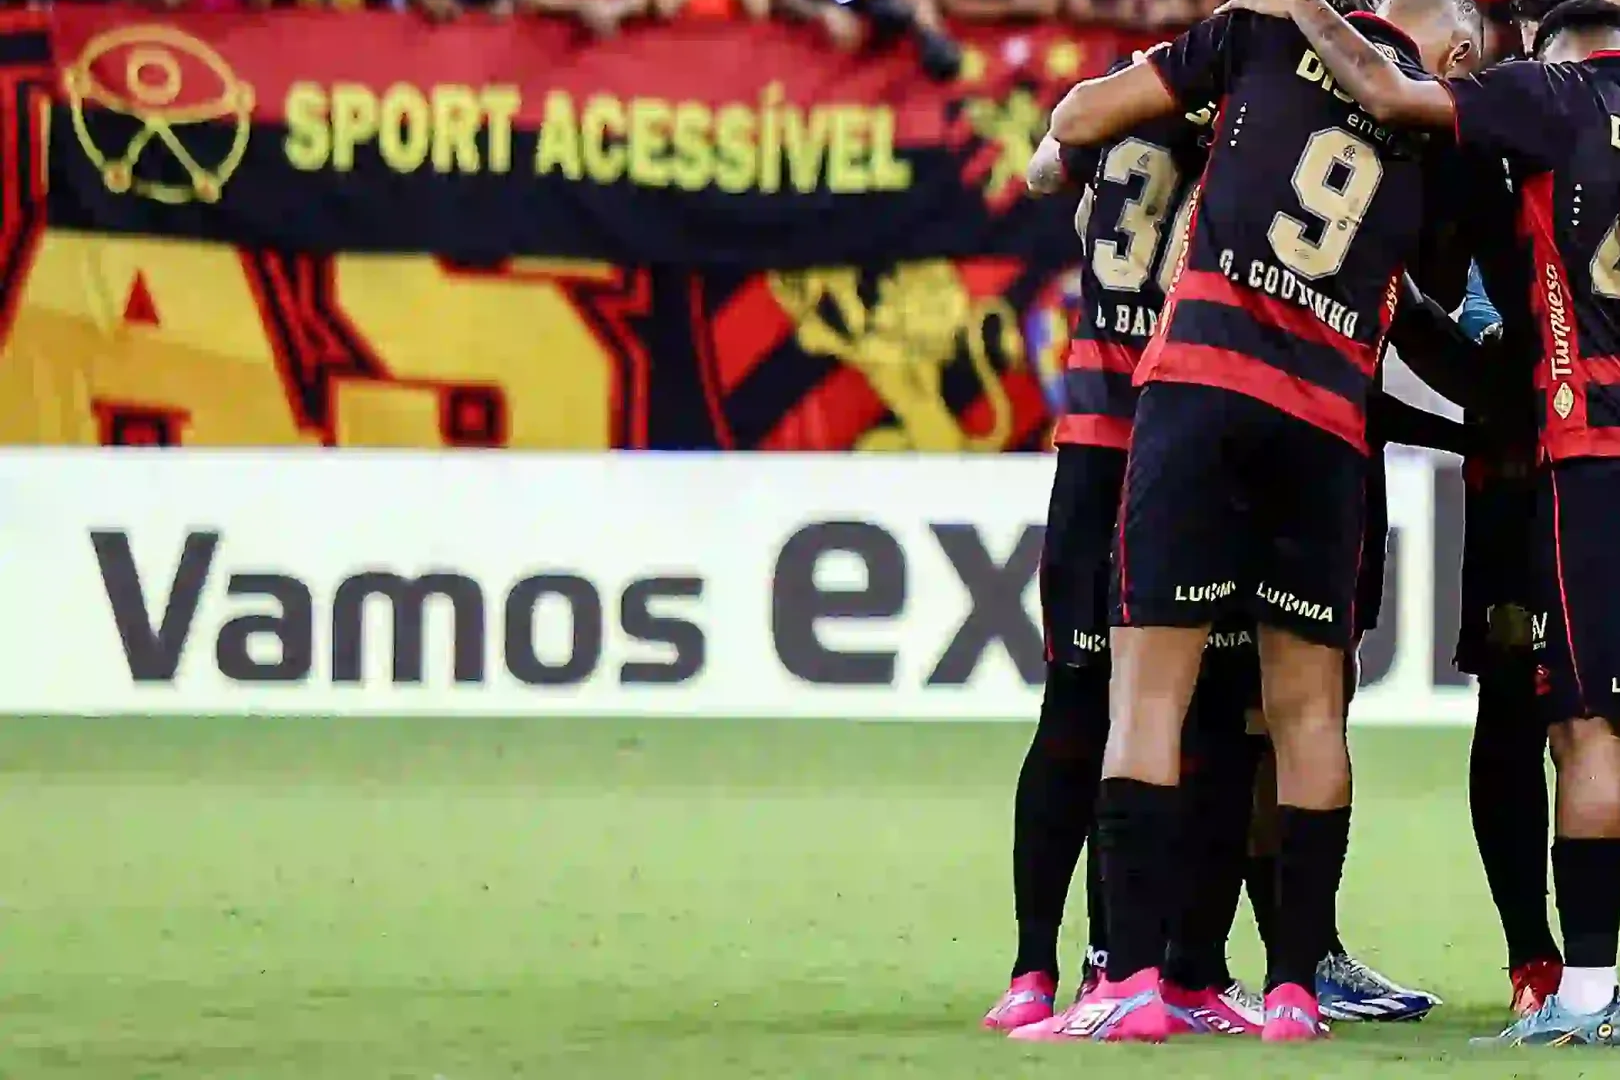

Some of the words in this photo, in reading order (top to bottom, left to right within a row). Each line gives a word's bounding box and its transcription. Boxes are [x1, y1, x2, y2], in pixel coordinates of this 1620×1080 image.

[284, 81, 521, 173] SPORT
[534, 79, 912, 194] ACESSÍVEL
[1267, 126, 1384, 281] 9
[1546, 262, 1573, 381] Turquesa
[88, 527, 706, 688] Vamos
